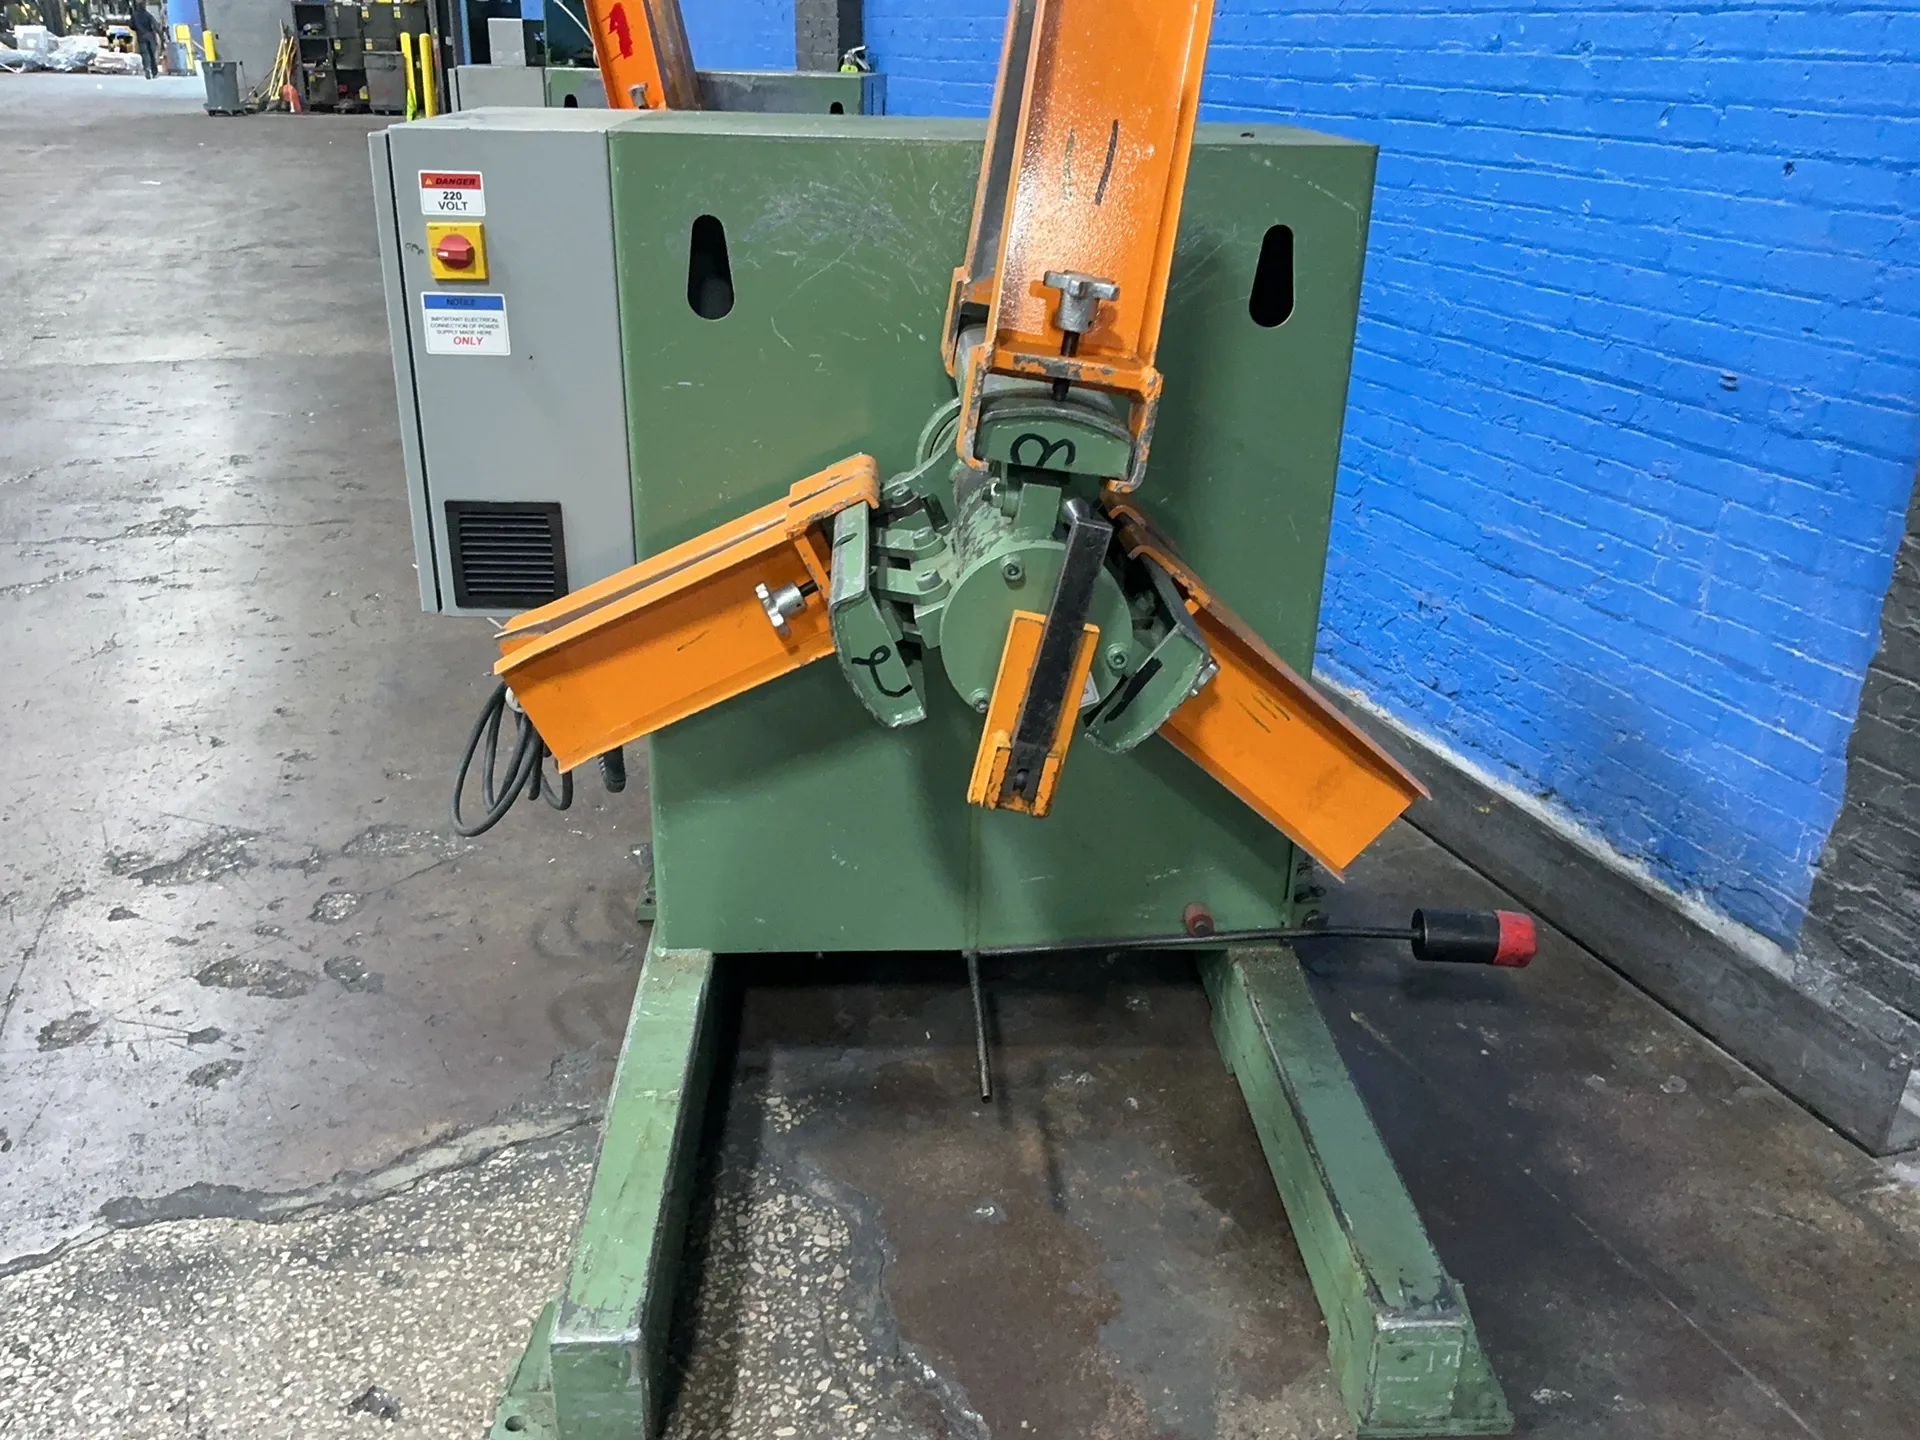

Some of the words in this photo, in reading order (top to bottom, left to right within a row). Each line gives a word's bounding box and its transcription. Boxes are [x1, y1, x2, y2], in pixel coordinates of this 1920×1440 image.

[435, 177, 476, 186] DANGER
[442, 191, 462, 201] 220
[437, 201, 468, 211] VOLT
[446, 298, 476, 307] NOTICE
[453, 336, 484, 346] ONLY
